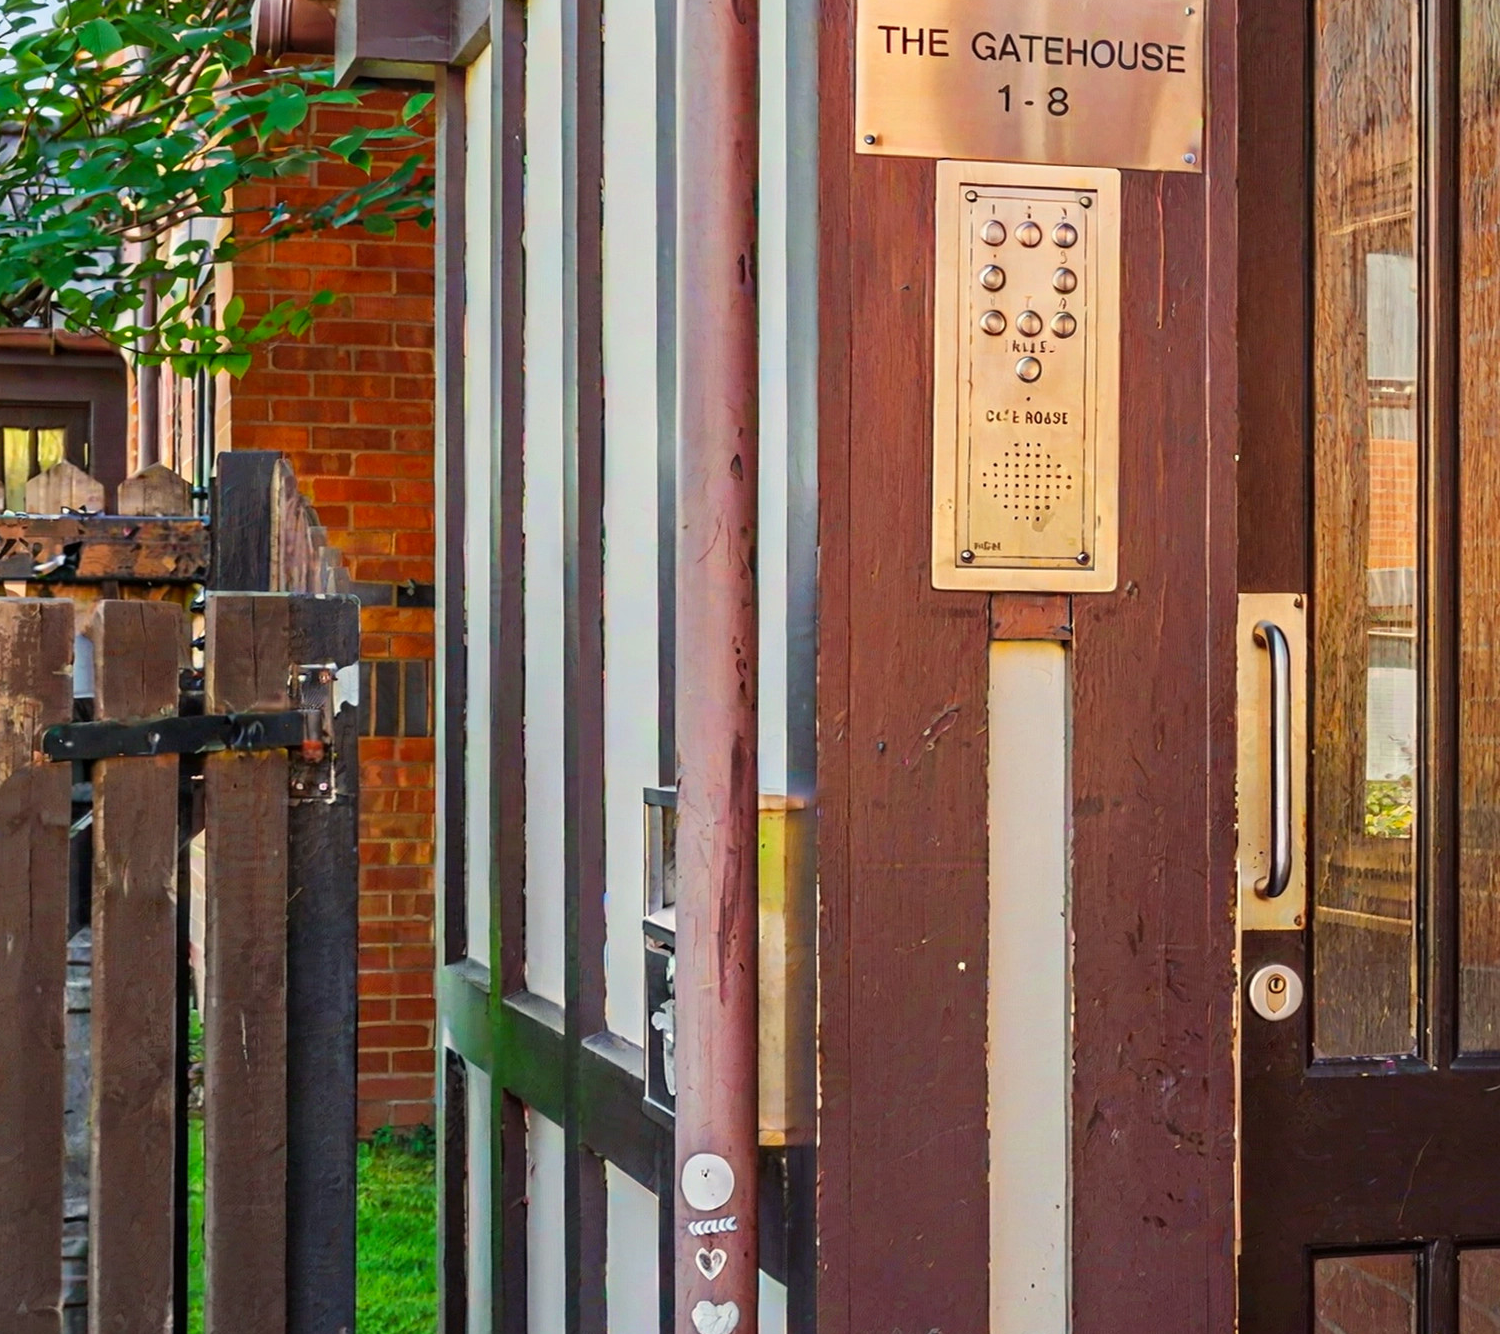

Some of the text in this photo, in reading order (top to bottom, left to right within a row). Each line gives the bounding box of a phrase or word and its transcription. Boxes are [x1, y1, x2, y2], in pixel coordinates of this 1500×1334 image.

[877, 25, 1186, 73] THE GATEHOUSE
[998, 84, 1011, 112] 1
[1047, 86, 1069, 116] 8
